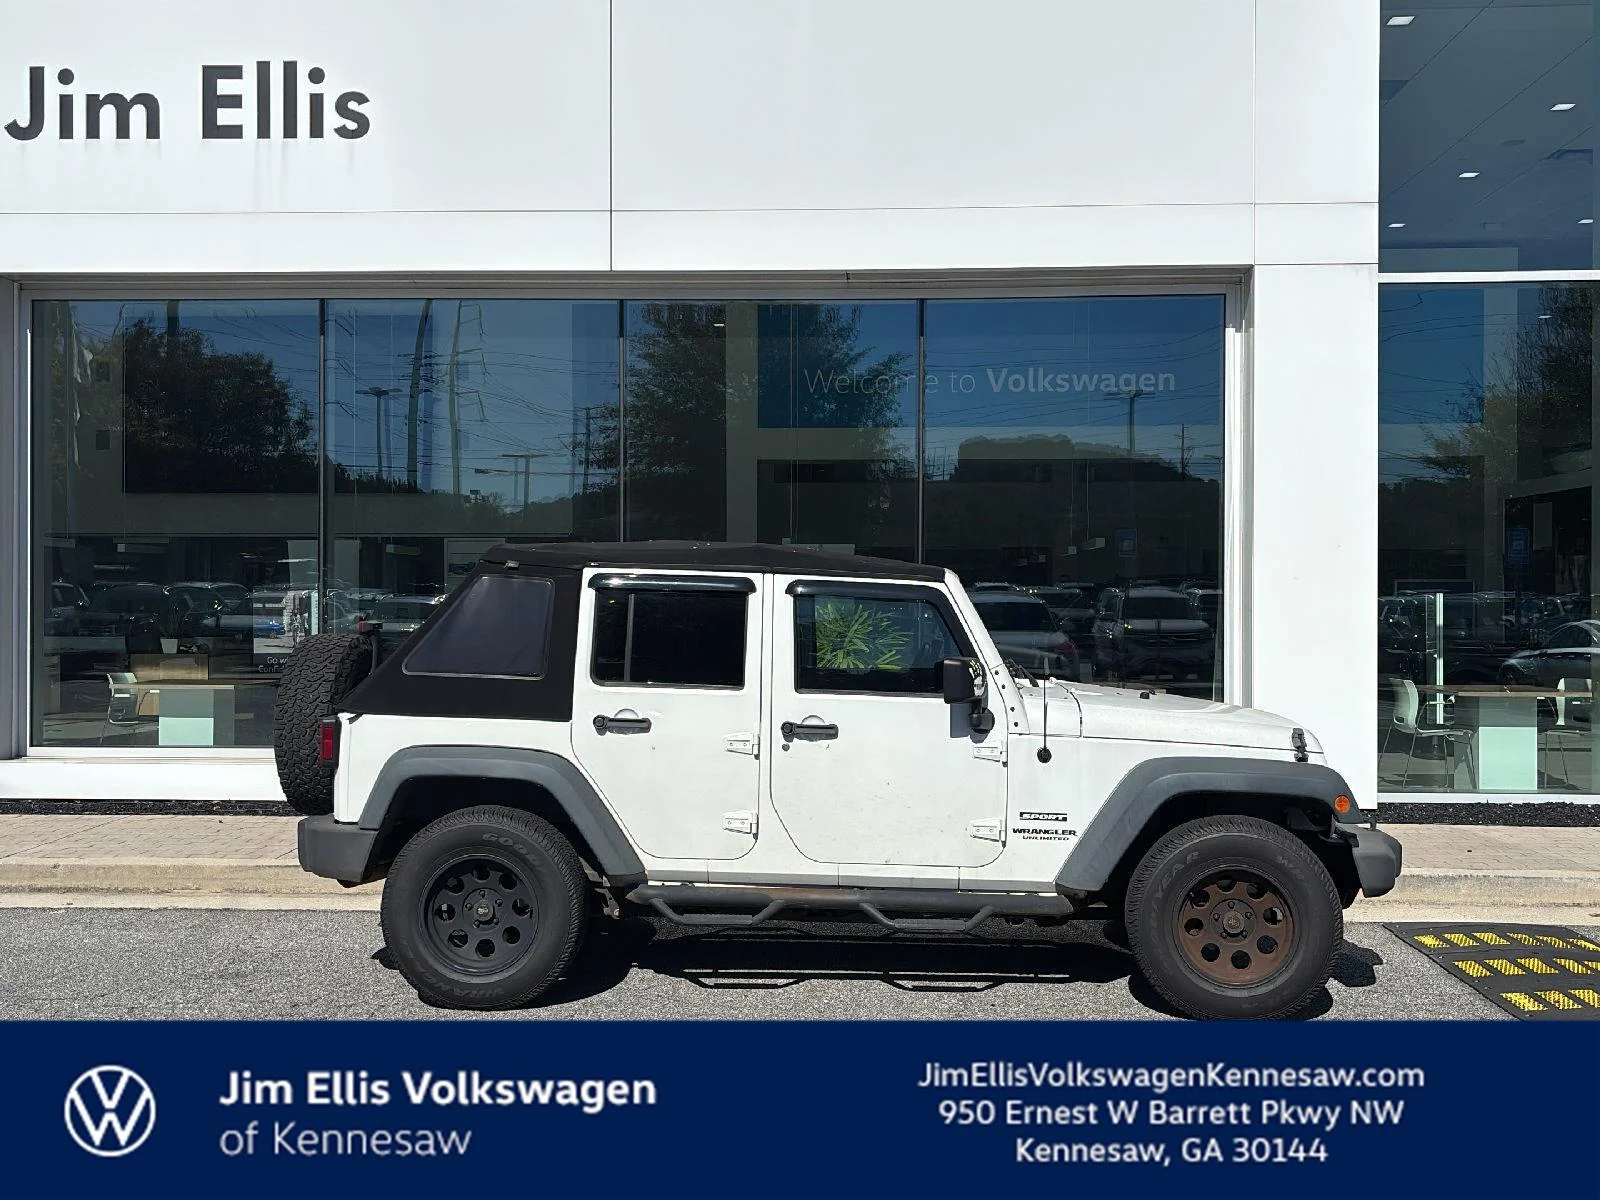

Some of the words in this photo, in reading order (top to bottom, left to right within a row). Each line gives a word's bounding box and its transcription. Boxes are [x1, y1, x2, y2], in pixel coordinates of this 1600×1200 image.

[4, 66, 160, 141] Jim
[202, 60, 370, 139] Ellis
[804, 368, 939, 394] Welcome
[950, 371, 976, 394] to
[986, 367, 1176, 398] Volkswagen
[1021, 812, 1066, 821] SPORT
[1012, 827, 1078, 837] WRANGLER
